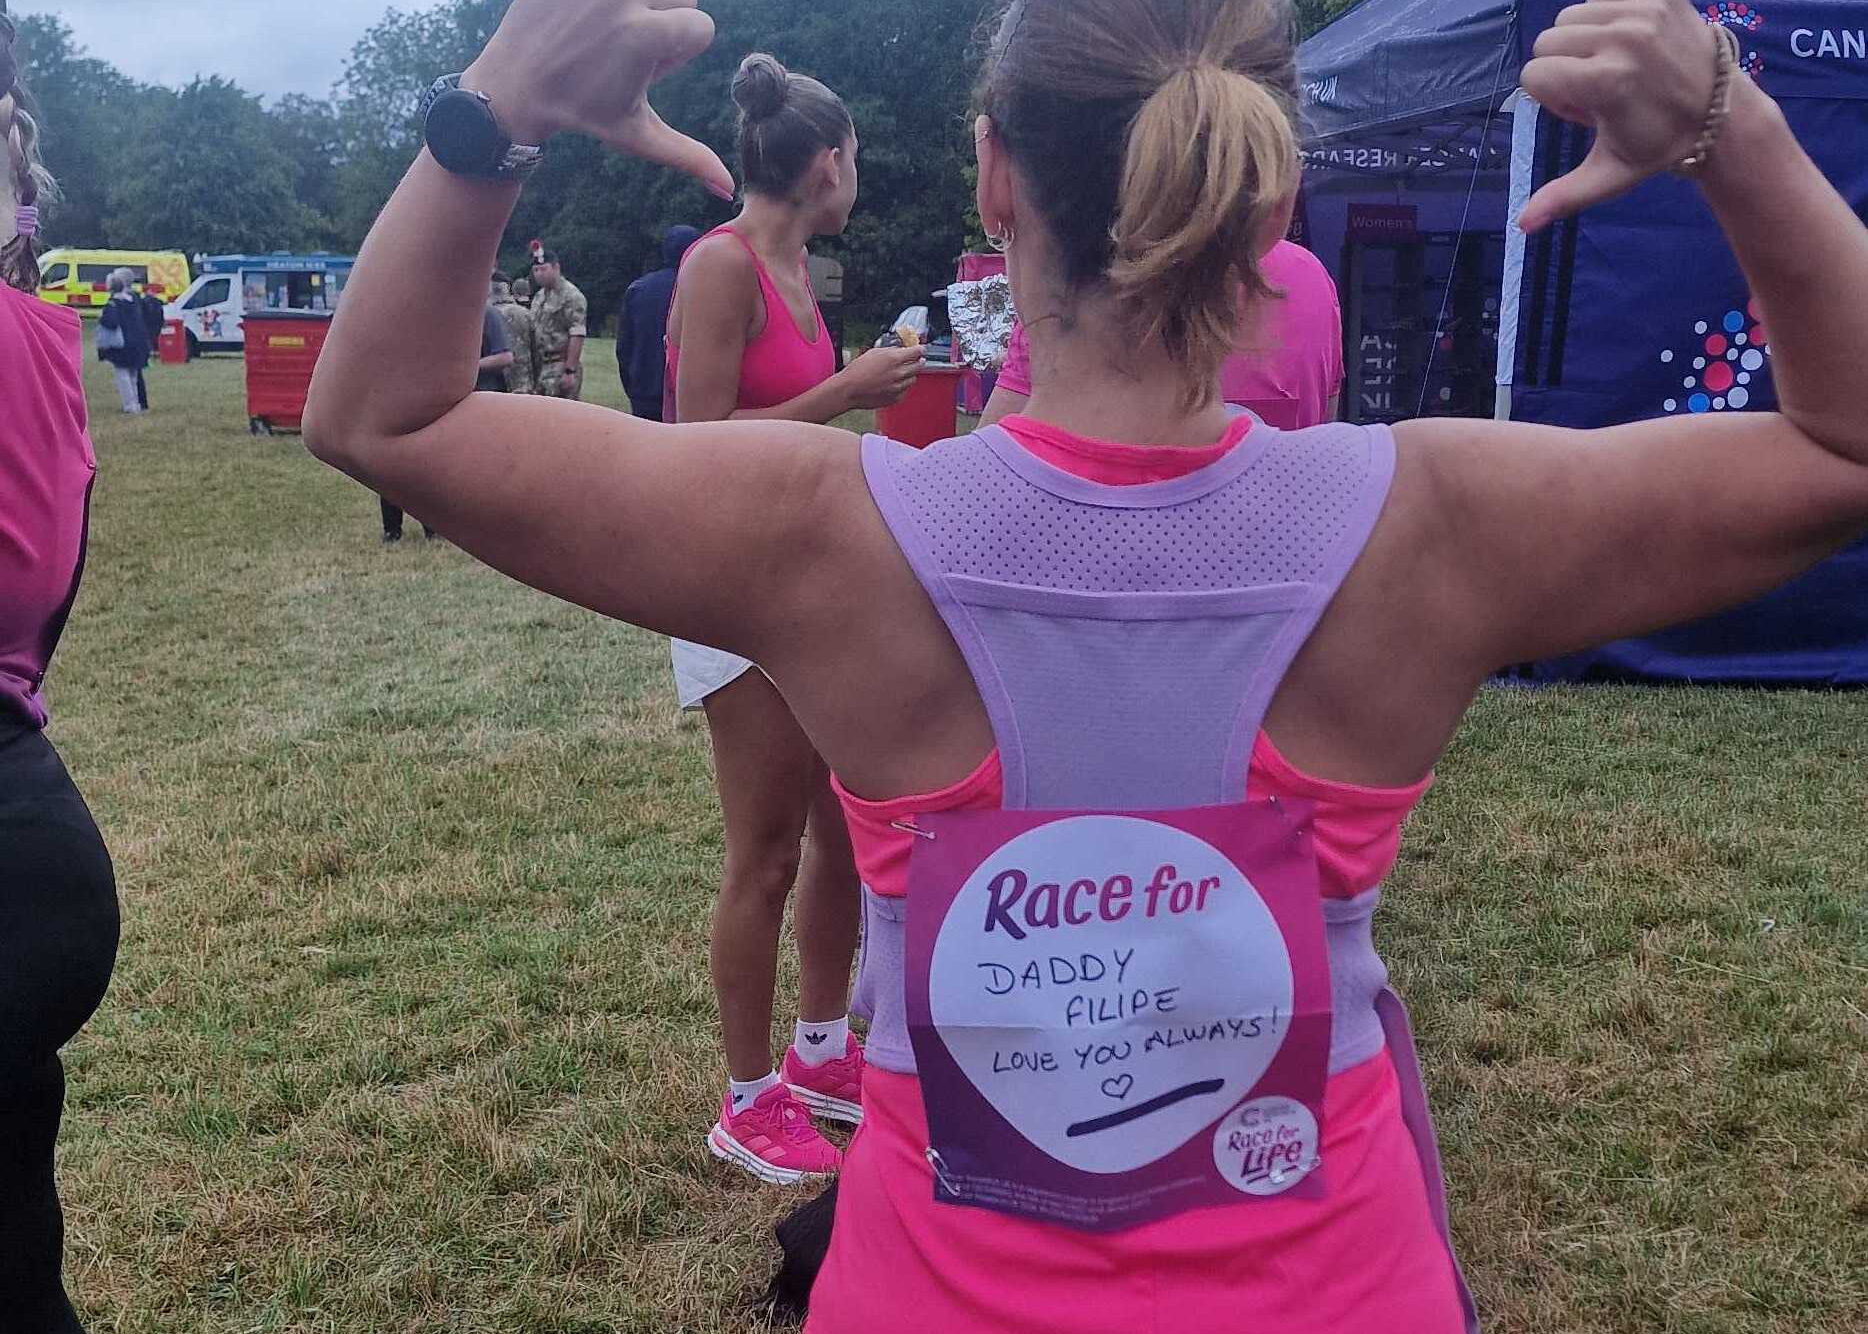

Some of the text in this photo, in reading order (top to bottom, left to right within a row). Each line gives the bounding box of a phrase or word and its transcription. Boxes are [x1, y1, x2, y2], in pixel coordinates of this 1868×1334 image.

[1791, 28, 1866, 59] CAN
[984, 865, 1220, 940] Race for
[977, 948, 1135, 995] DADDY
[1066, 986, 1180, 1027] FILIPE
[993, 1006, 1278, 1073] LOVE YOU ALWAYS!
[1228, 1124, 1300, 1151] Race for
